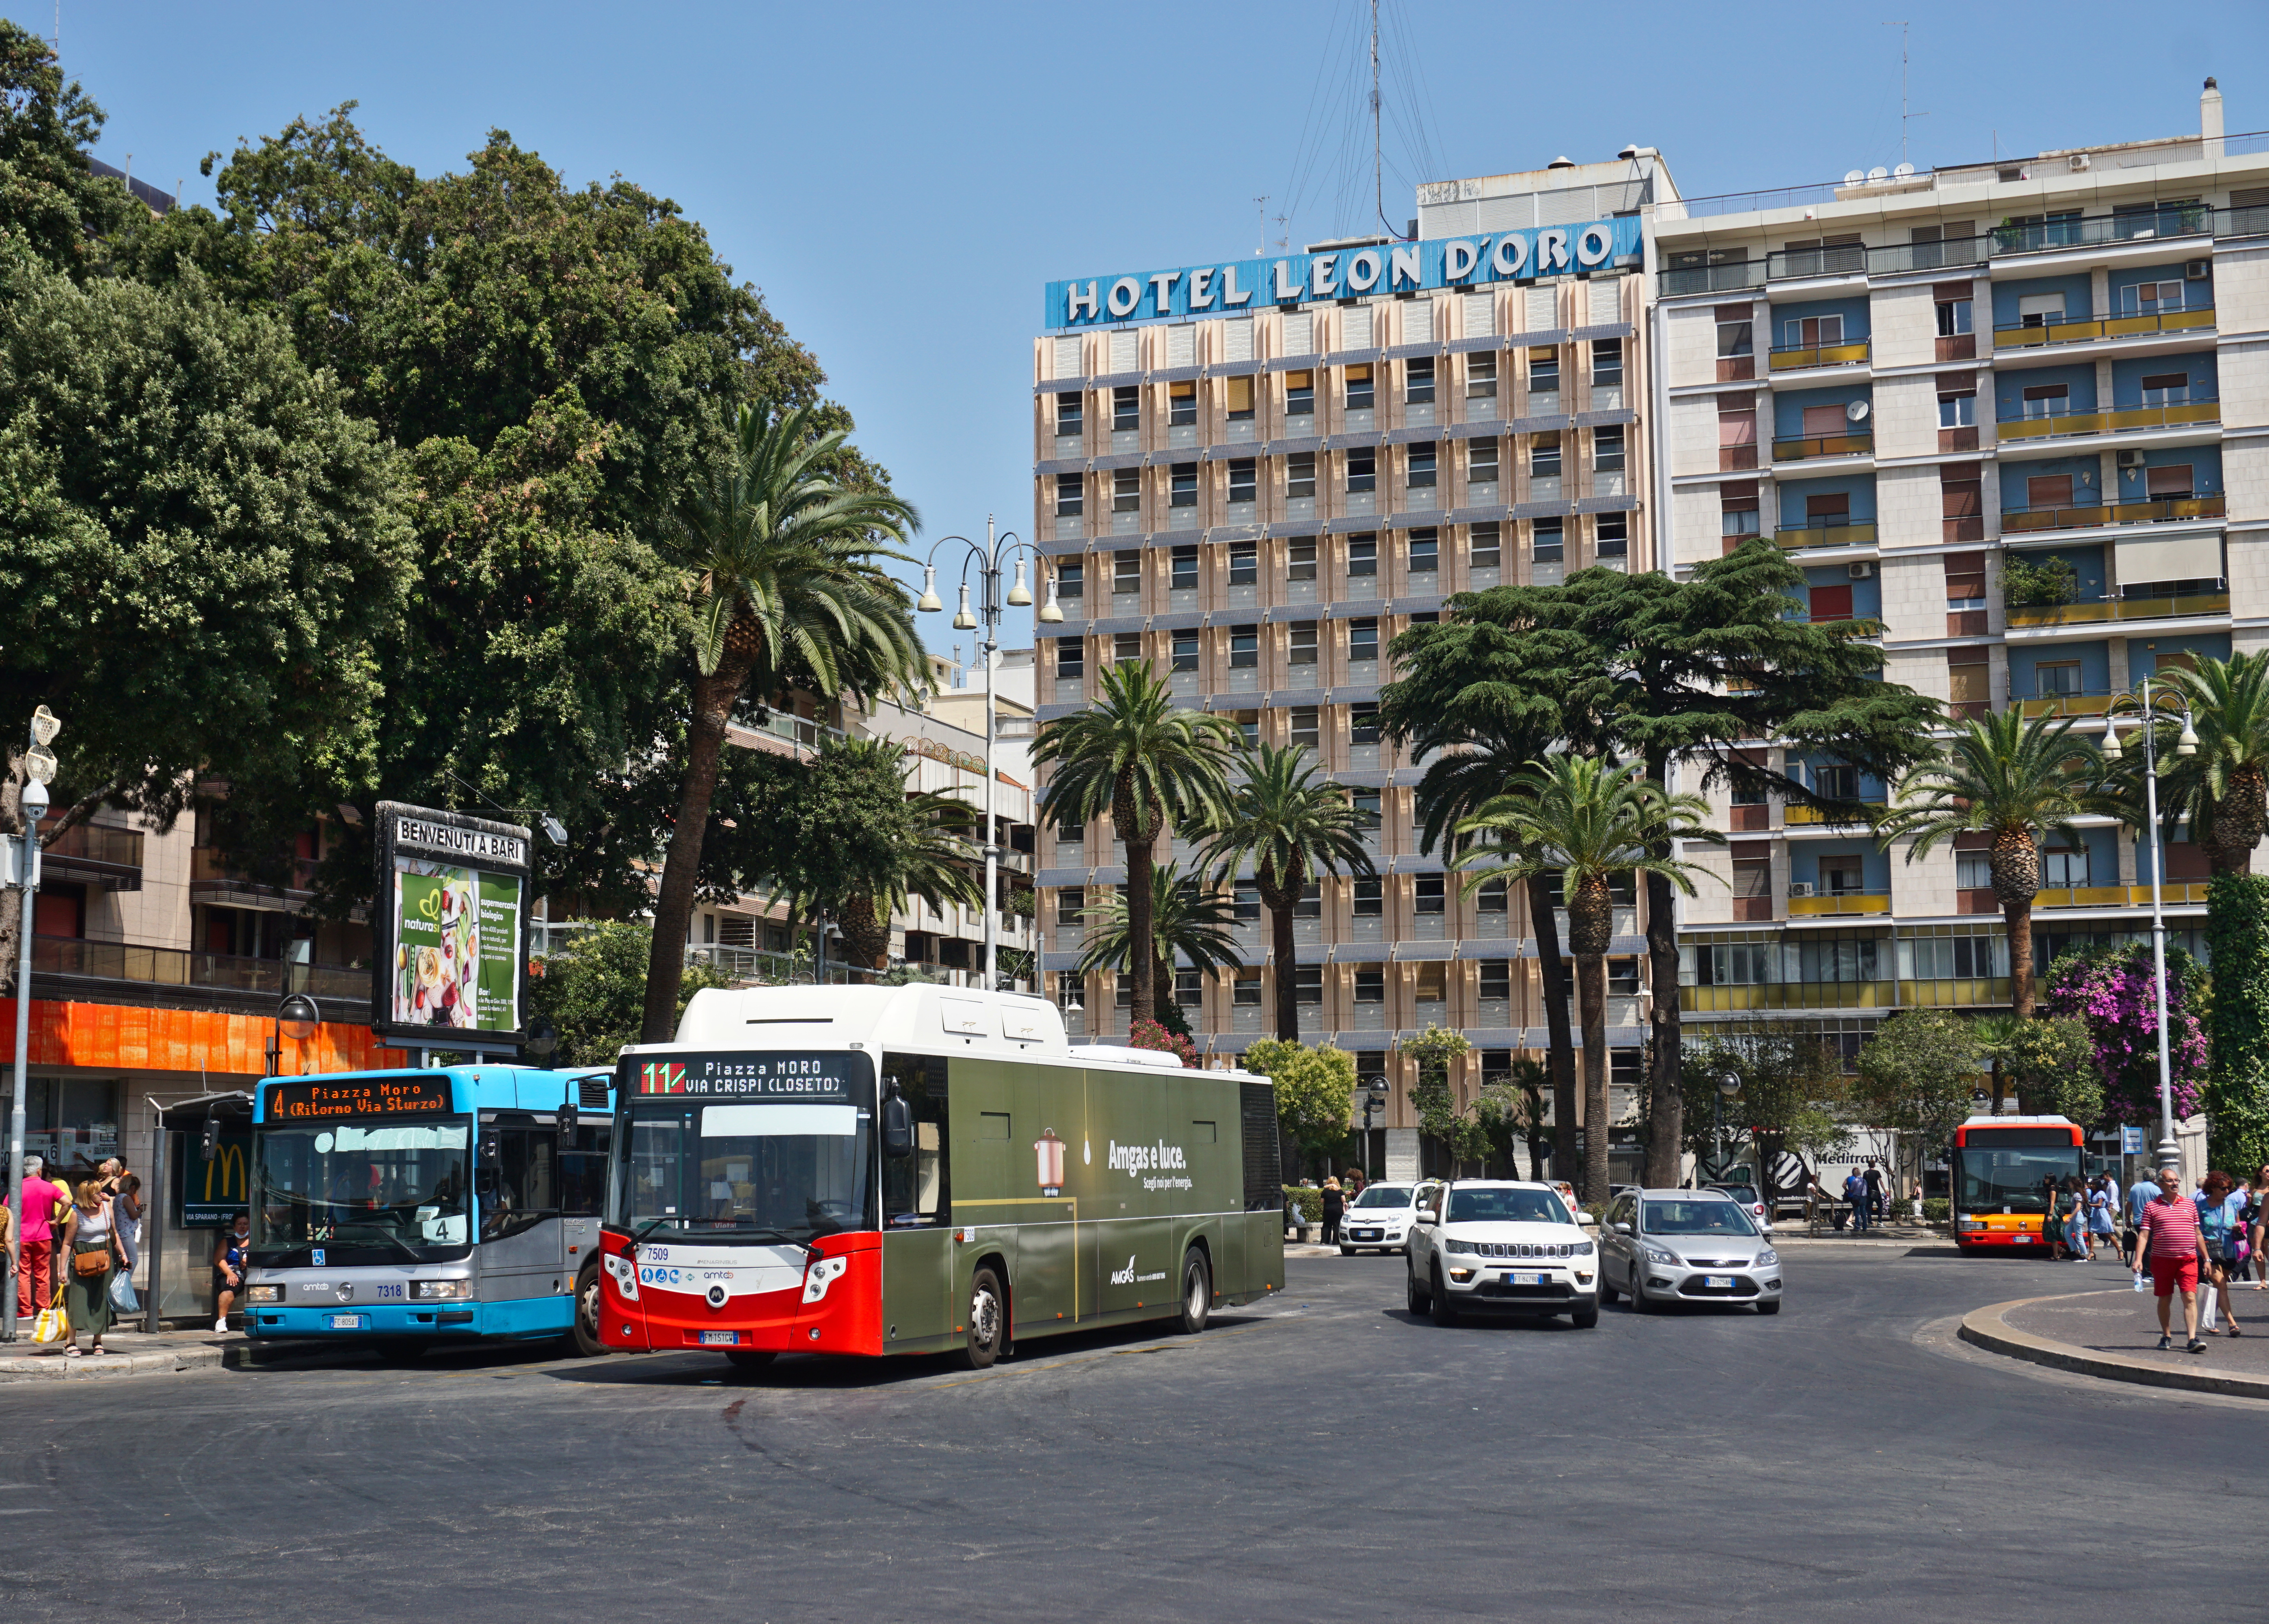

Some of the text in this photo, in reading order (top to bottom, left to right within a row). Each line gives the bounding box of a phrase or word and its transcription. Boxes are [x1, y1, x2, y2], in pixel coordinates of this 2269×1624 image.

[1068, 224, 1613, 322] HOTEL LEON D'ORO
[402, 820, 518, 859] BENVENUTI A BARI
[481, 899, 516, 910] supermercato
[481, 909, 503, 922] biologico
[706, 1060, 821, 1075] Piazza MORO
[312, 1083, 421, 1100] Piazza Moro
[686, 1077, 840, 1093] VIA CRISPI (LOSETO)
[274, 1090, 283, 1118] 4
[290, 1094, 443, 1116] (Ritorno Via Sturzo)
[1109, 1139, 1186, 1177] Amgas e luce.
[1816, 1153, 1885, 1164] Meditrans
[1143, 1176, 1156, 1192] Scegli
[1172, 1176, 1193, 1191] l'energia.
[436, 1220, 449, 1239] 4
[965, 1229, 974, 1241] 7509
[647, 1248, 668, 1260] 7509
[1111, 1269, 1134, 1285] AMGAS
[377, 1285, 401, 1298] 7318
